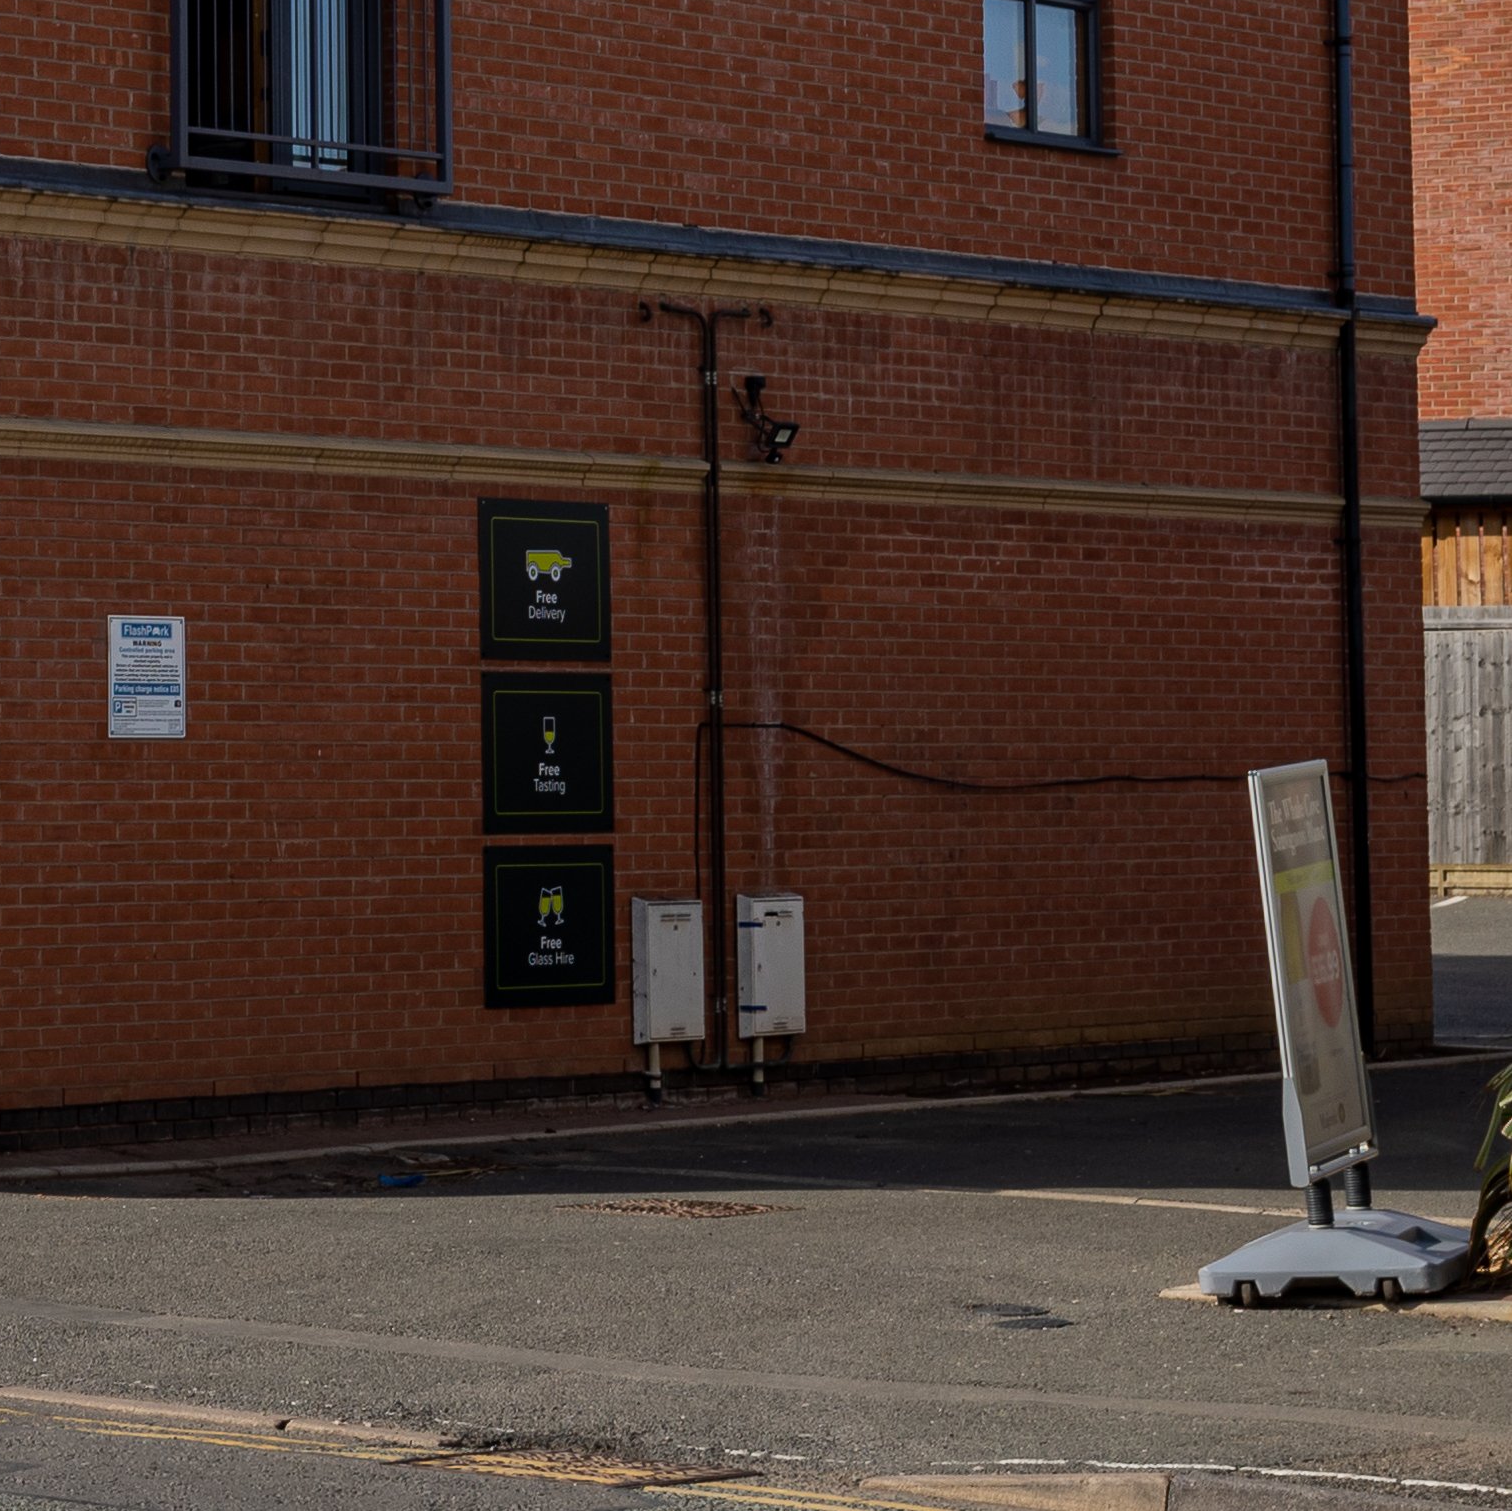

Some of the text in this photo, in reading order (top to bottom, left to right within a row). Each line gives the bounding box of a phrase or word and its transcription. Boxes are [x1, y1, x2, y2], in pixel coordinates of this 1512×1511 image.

[536, 590, 558, 604] Free
[528, 605, 566, 623] Delivery
[538, 762, 560, 776] Free
[533, 778, 566, 795] Tasting
[540, 936, 562, 949] Free
[528, 951, 575, 965] Glass Hire
